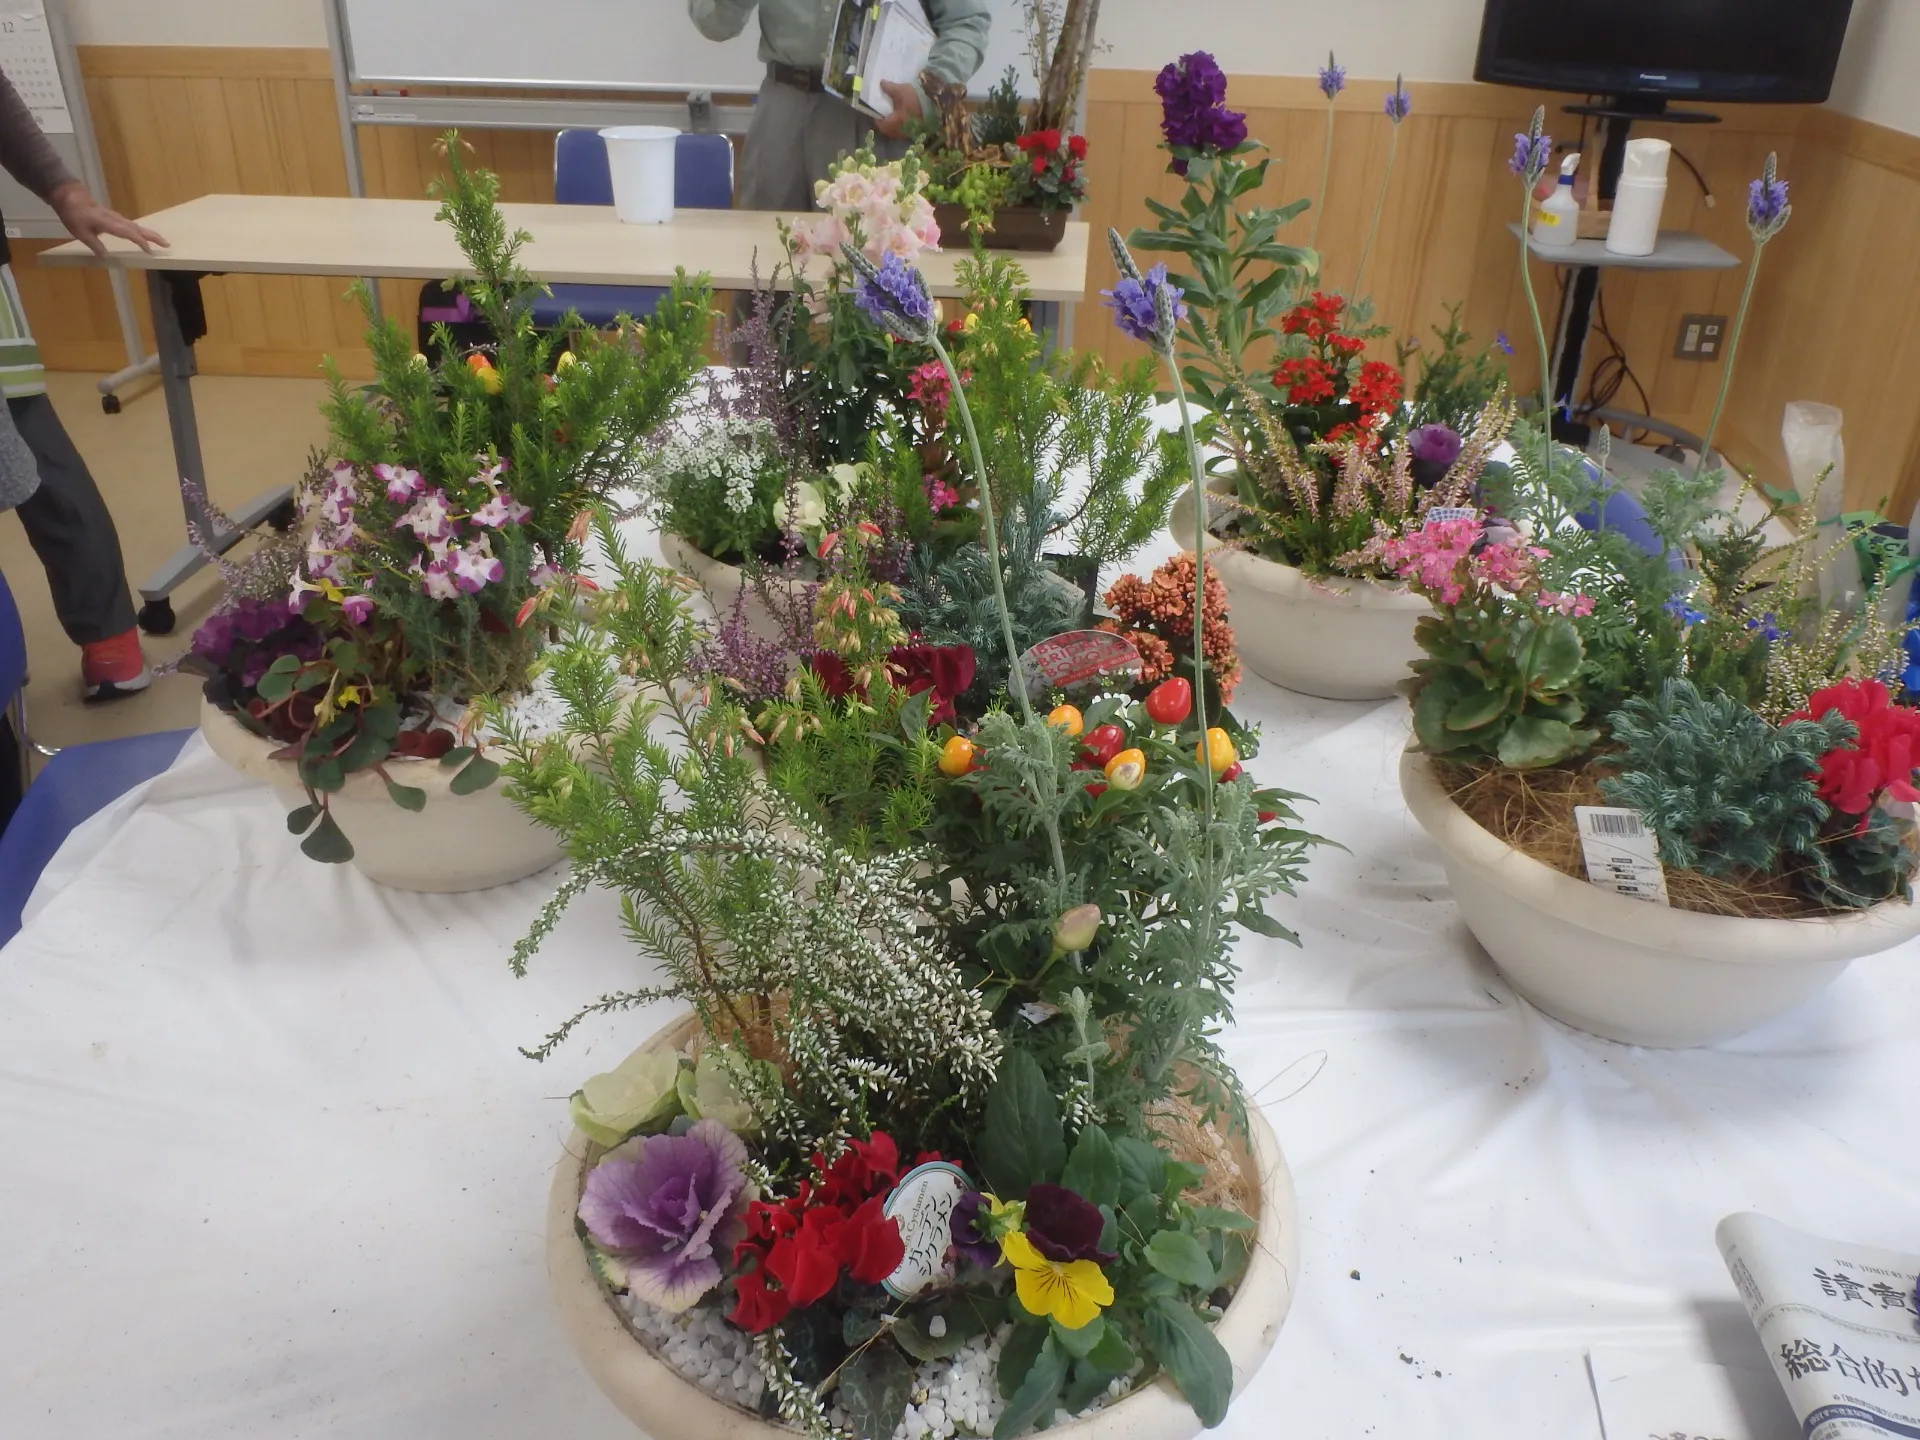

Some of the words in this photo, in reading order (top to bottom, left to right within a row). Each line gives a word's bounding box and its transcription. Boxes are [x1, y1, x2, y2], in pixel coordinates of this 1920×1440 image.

[2, 21, 14, 33] 12
[907, 1180, 929, 1232] Cyclamen
[908, 1195, 937, 1267] ガーデン
[918, 1191, 953, 1277] シクラメン
